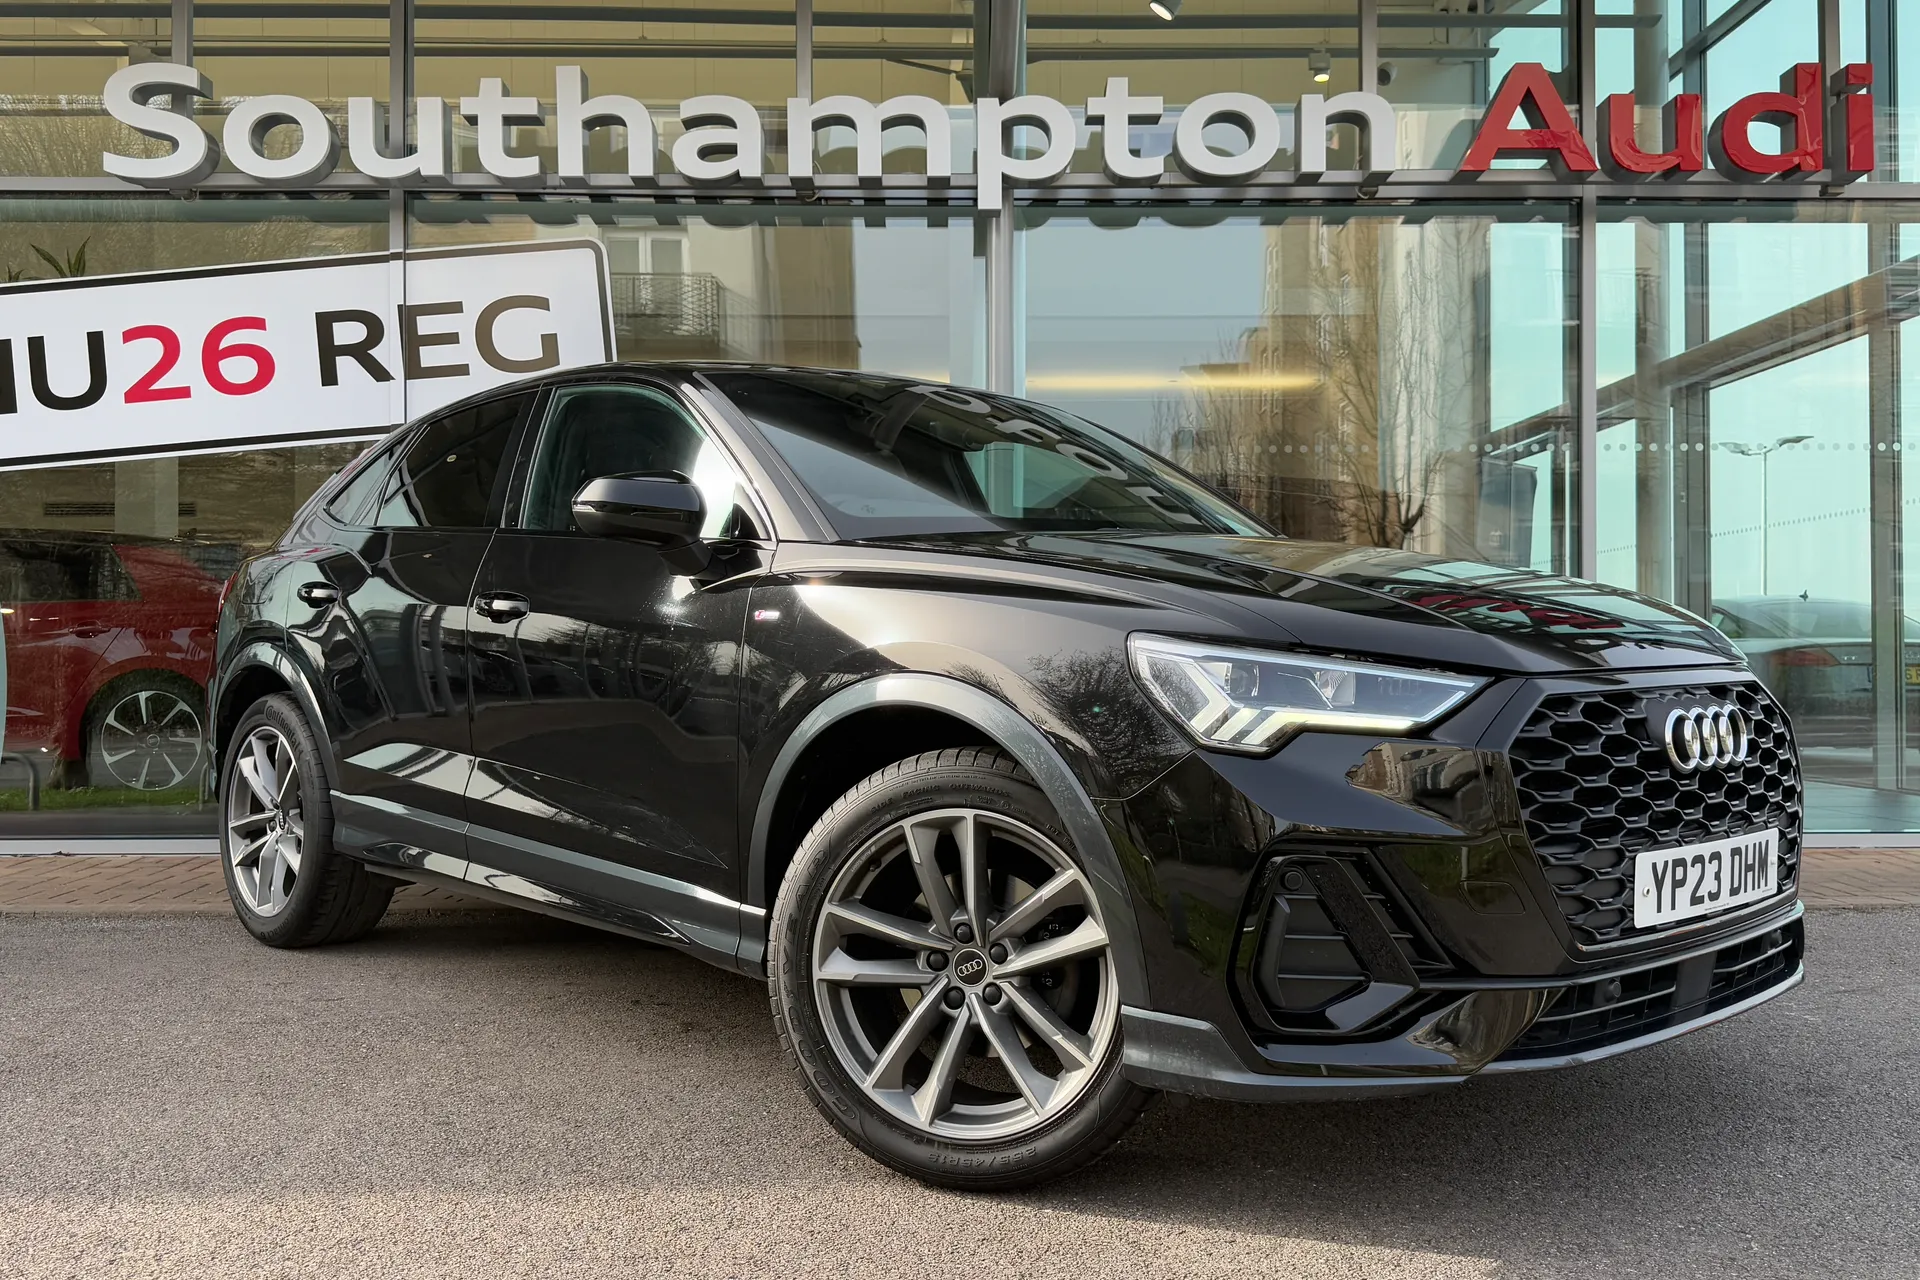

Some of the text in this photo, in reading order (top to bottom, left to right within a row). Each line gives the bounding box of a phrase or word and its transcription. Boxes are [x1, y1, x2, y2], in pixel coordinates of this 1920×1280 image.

[102, 61, 1874, 213] Southampton Audi
[0, 294, 560, 415] U26 REG
[265, 705, 301, 752] Continental
[1651, 839, 1770, 914] YP23 DHM
[782, 848, 857, 1121] GOODYEAR
